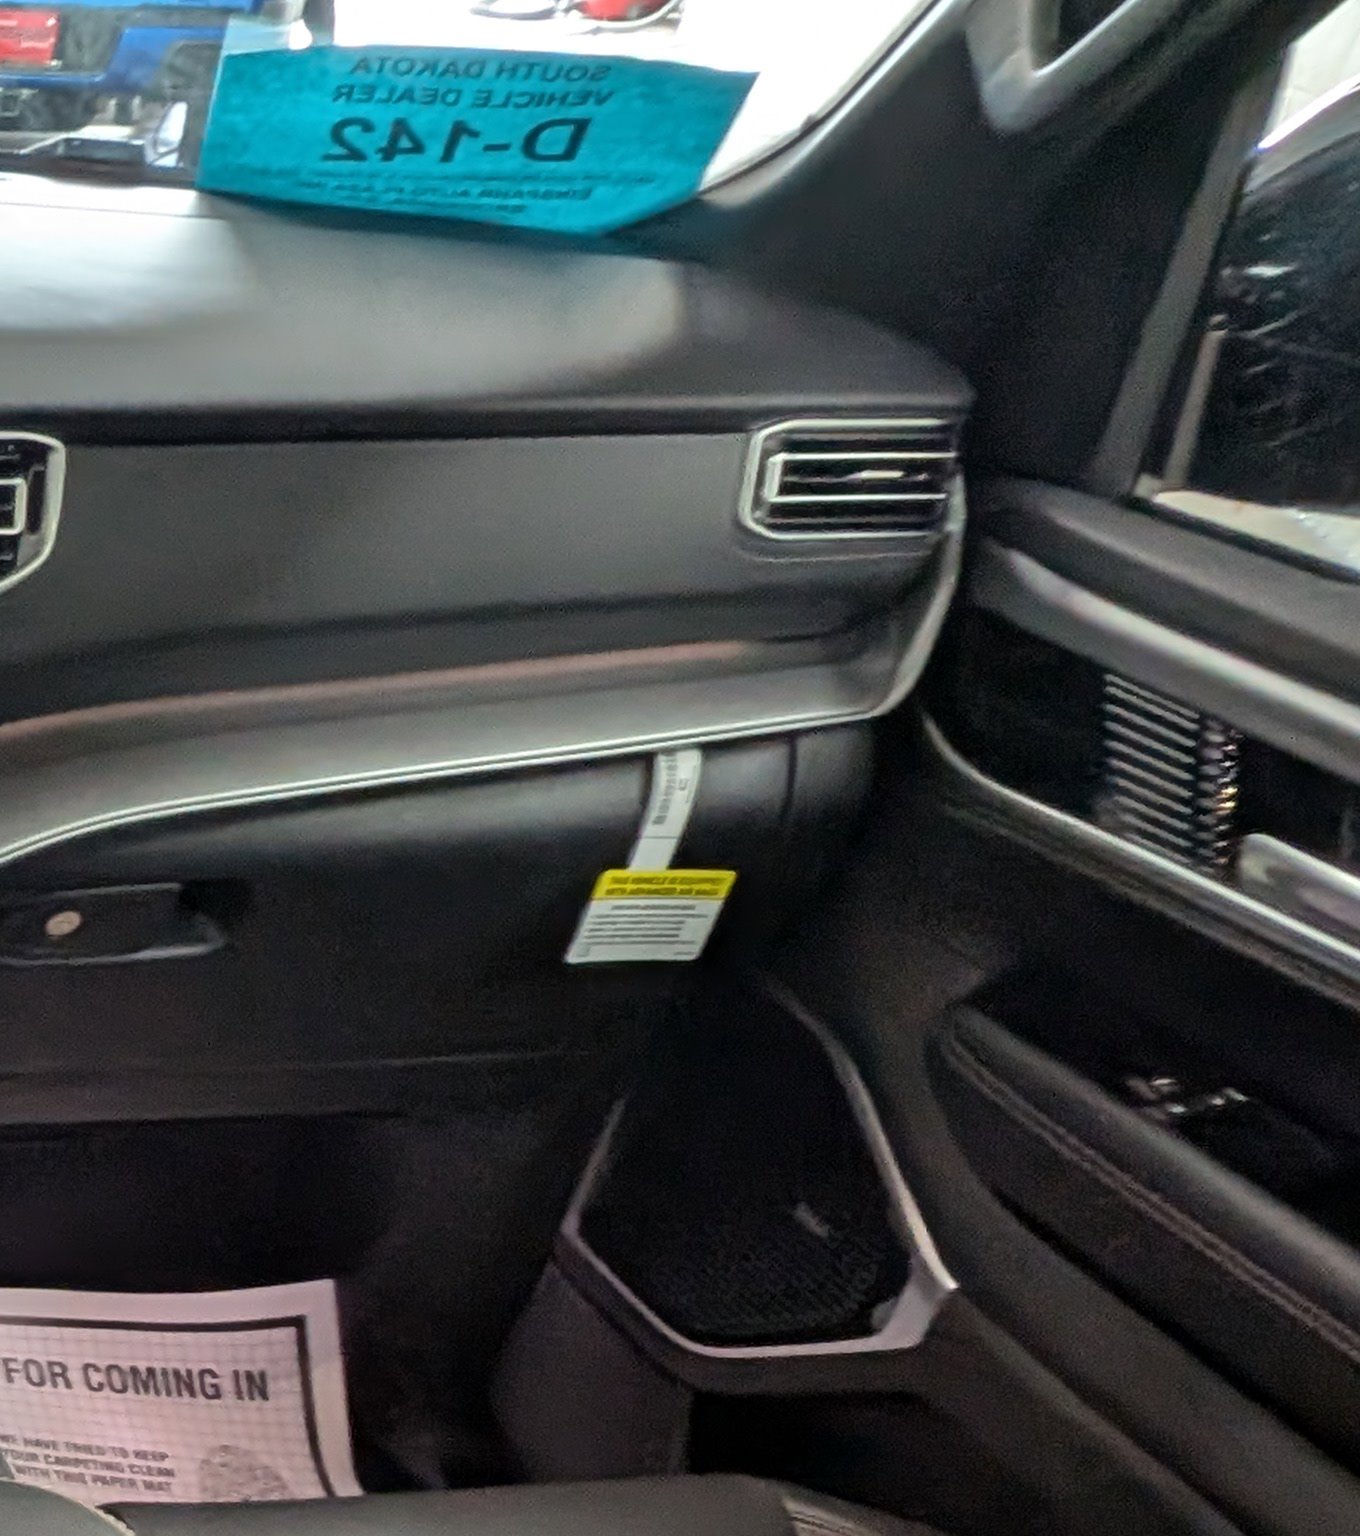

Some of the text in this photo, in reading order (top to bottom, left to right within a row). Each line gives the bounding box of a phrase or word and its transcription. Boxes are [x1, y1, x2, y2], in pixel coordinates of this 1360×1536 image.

[0, 1356, 73, 1390] FOR
[82, 1362, 222, 1401] COMING
[231, 1368, 270, 1401] IN
